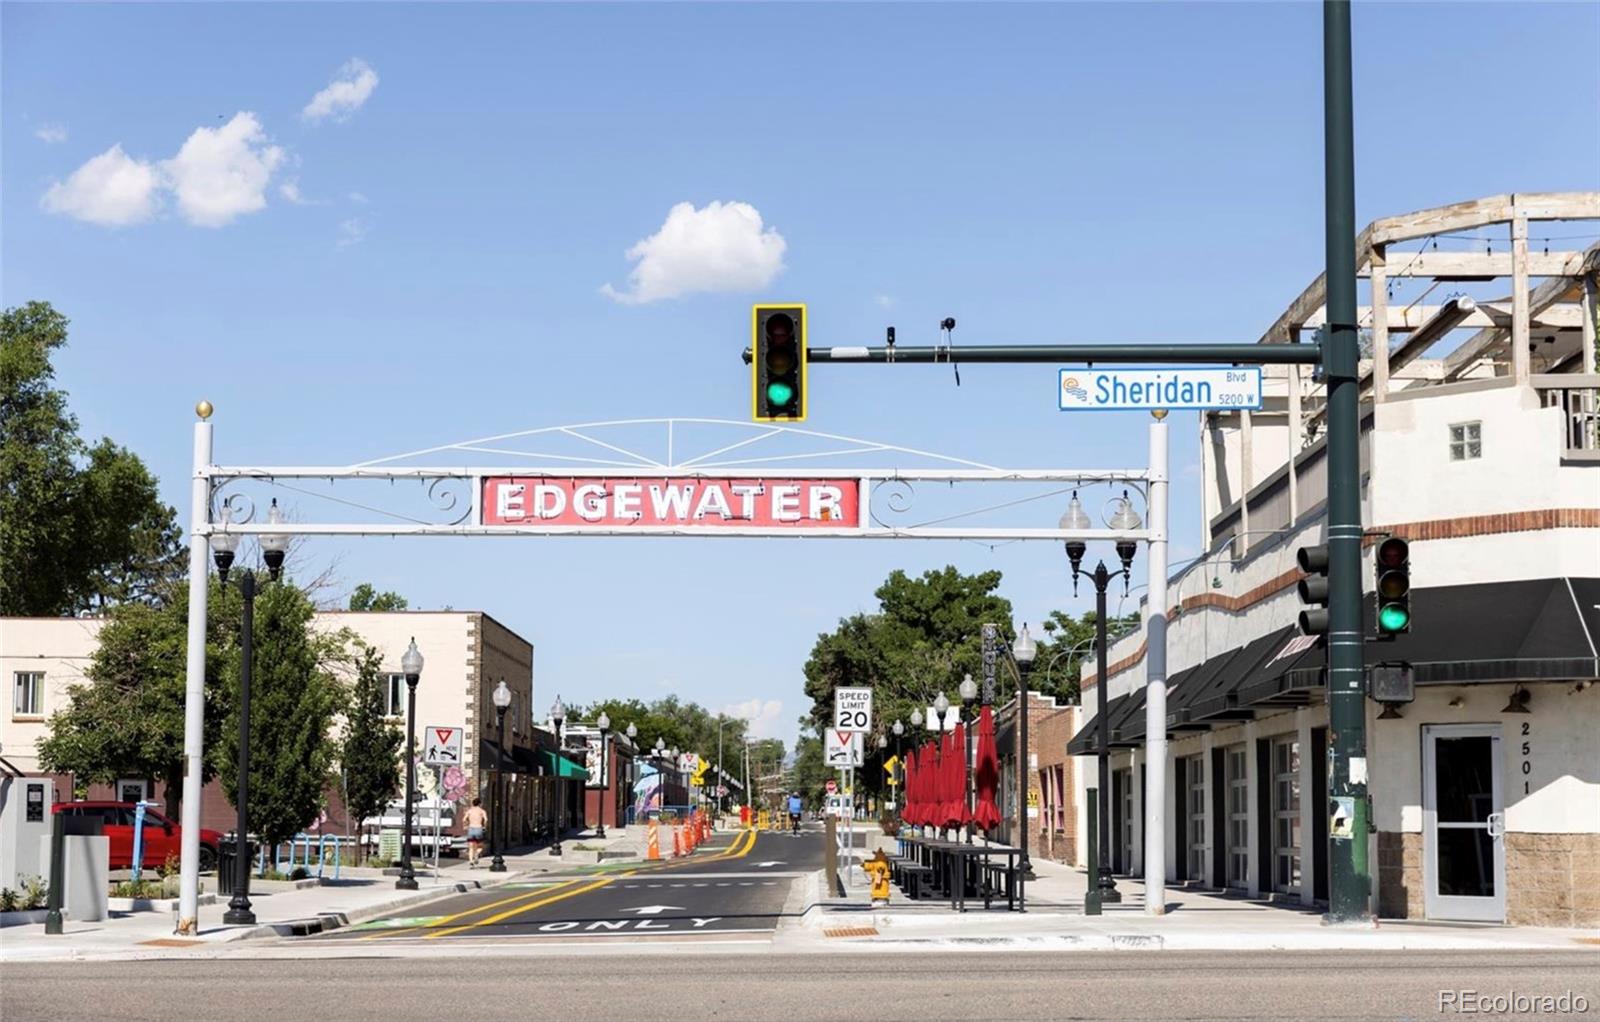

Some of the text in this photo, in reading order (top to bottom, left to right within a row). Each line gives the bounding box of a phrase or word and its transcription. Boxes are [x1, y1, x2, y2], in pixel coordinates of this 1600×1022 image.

[1226, 372, 1247, 383] Blvd
[1095, 374, 1211, 404] Sheridan
[1218, 394, 1254, 405] 5200 W
[495, 483, 843, 521] EDGEWATER
[838, 692, 869, 701] SPEED
[842, 701, 866, 710] LIMIT
[839, 711, 868, 728] 20
[1520, 722, 1531, 795] 2501
[538, 917, 722, 932] ONLY
